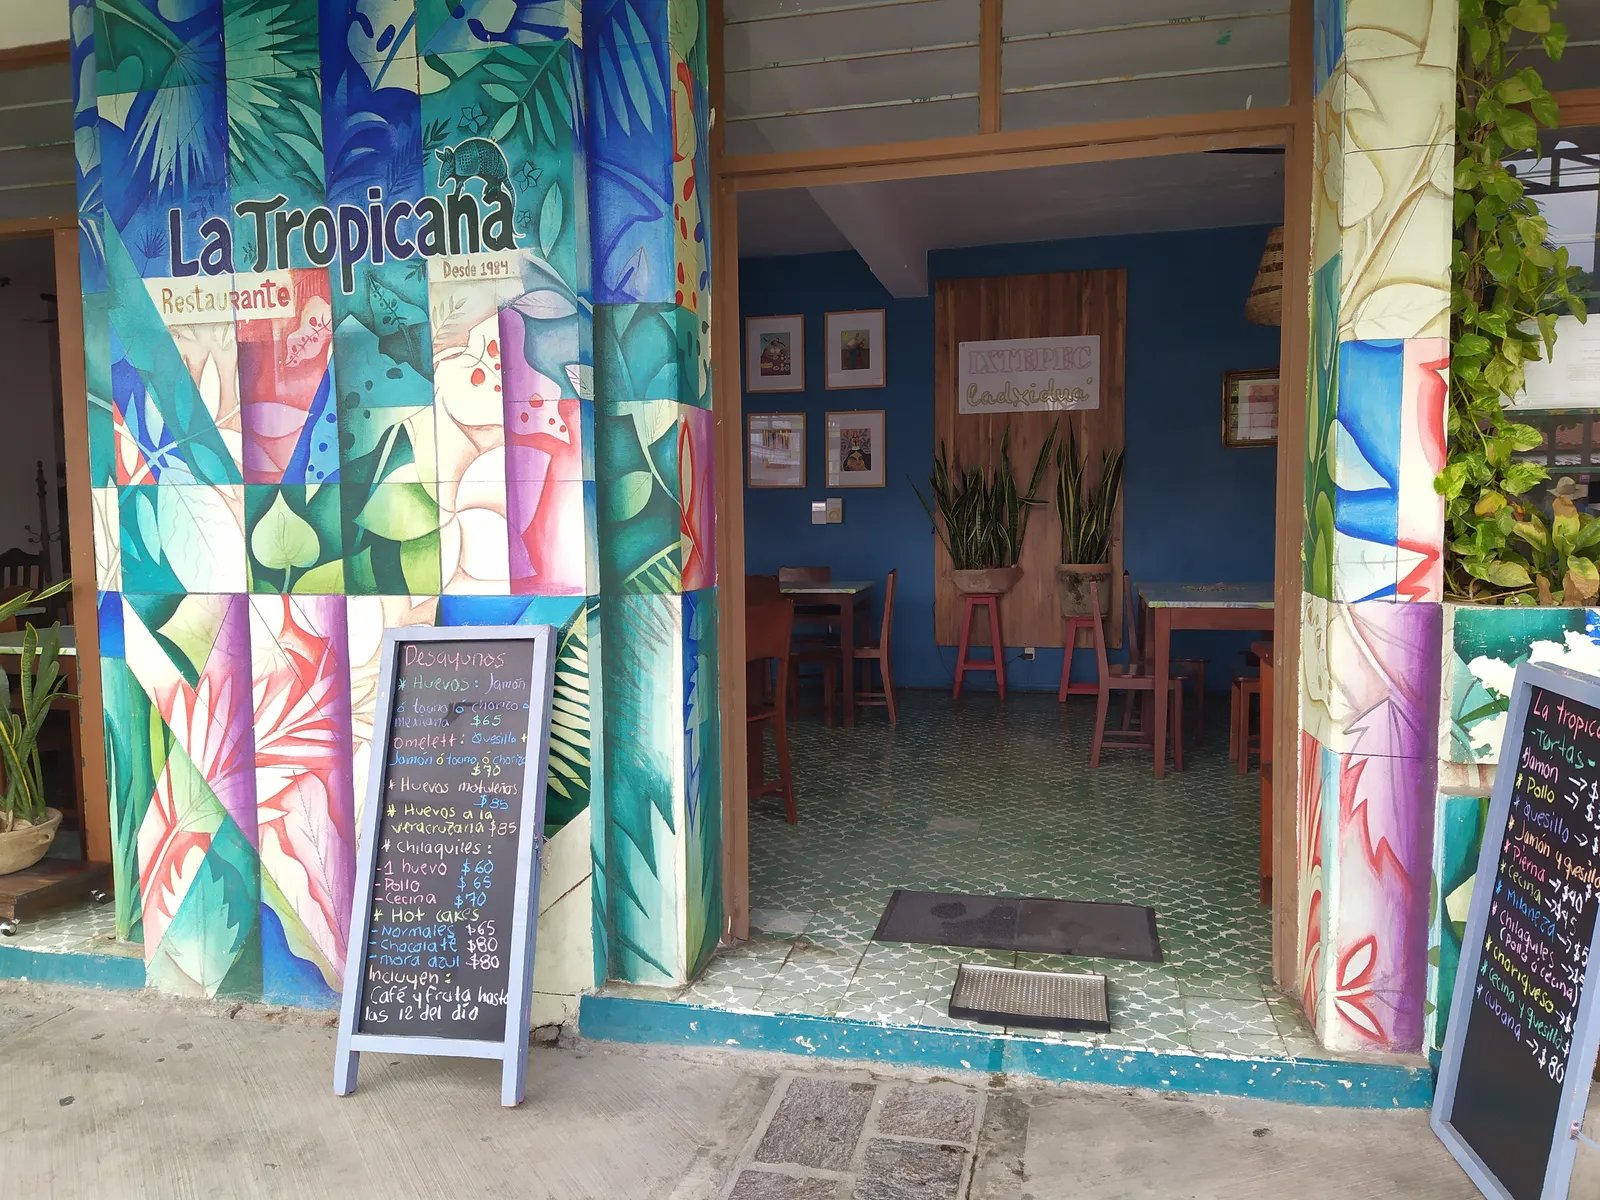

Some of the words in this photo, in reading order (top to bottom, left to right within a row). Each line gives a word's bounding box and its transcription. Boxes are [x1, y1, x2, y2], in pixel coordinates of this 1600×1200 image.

[169, 207, 235, 278] La
[235, 186, 520, 295] Tropicana
[442, 260, 478, 278] Desde
[479, 260, 510, 276] 1984
[162, 278, 291, 315] Restaurante
[968, 346, 1092, 374] IXTEPEC
[404, 644, 506, 671] Desayunos
[1533, 689, 1549, 721] La
[470, 714, 502, 728] $65
[470, 762, 501, 778] $70
[400, 776, 449, 794] Huevos
[1526, 776, 1555, 804] Pollo
[473, 794, 509, 809] $85
[404, 803, 456, 819] Huevos
[463, 809, 473, 820] a
[479, 809, 494, 820] la
[391, 820, 484, 836] veracruzana
[488, 819, 517, 837] $85
[402, 859, 448, 876] huevo
[1513, 844, 1546, 883] Pierna
[391, 907, 426, 923] Hot
[465, 920, 496, 936] $65
[466, 936, 498, 954] $80
[427, 955, 460, 969] azul
[465, 953, 500, 970] $80
[370, 985, 408, 1005] Café
[364, 1005, 390, 1023] las
[399, 1005, 414, 1020] 12
[419, 1003, 442, 1021] del
